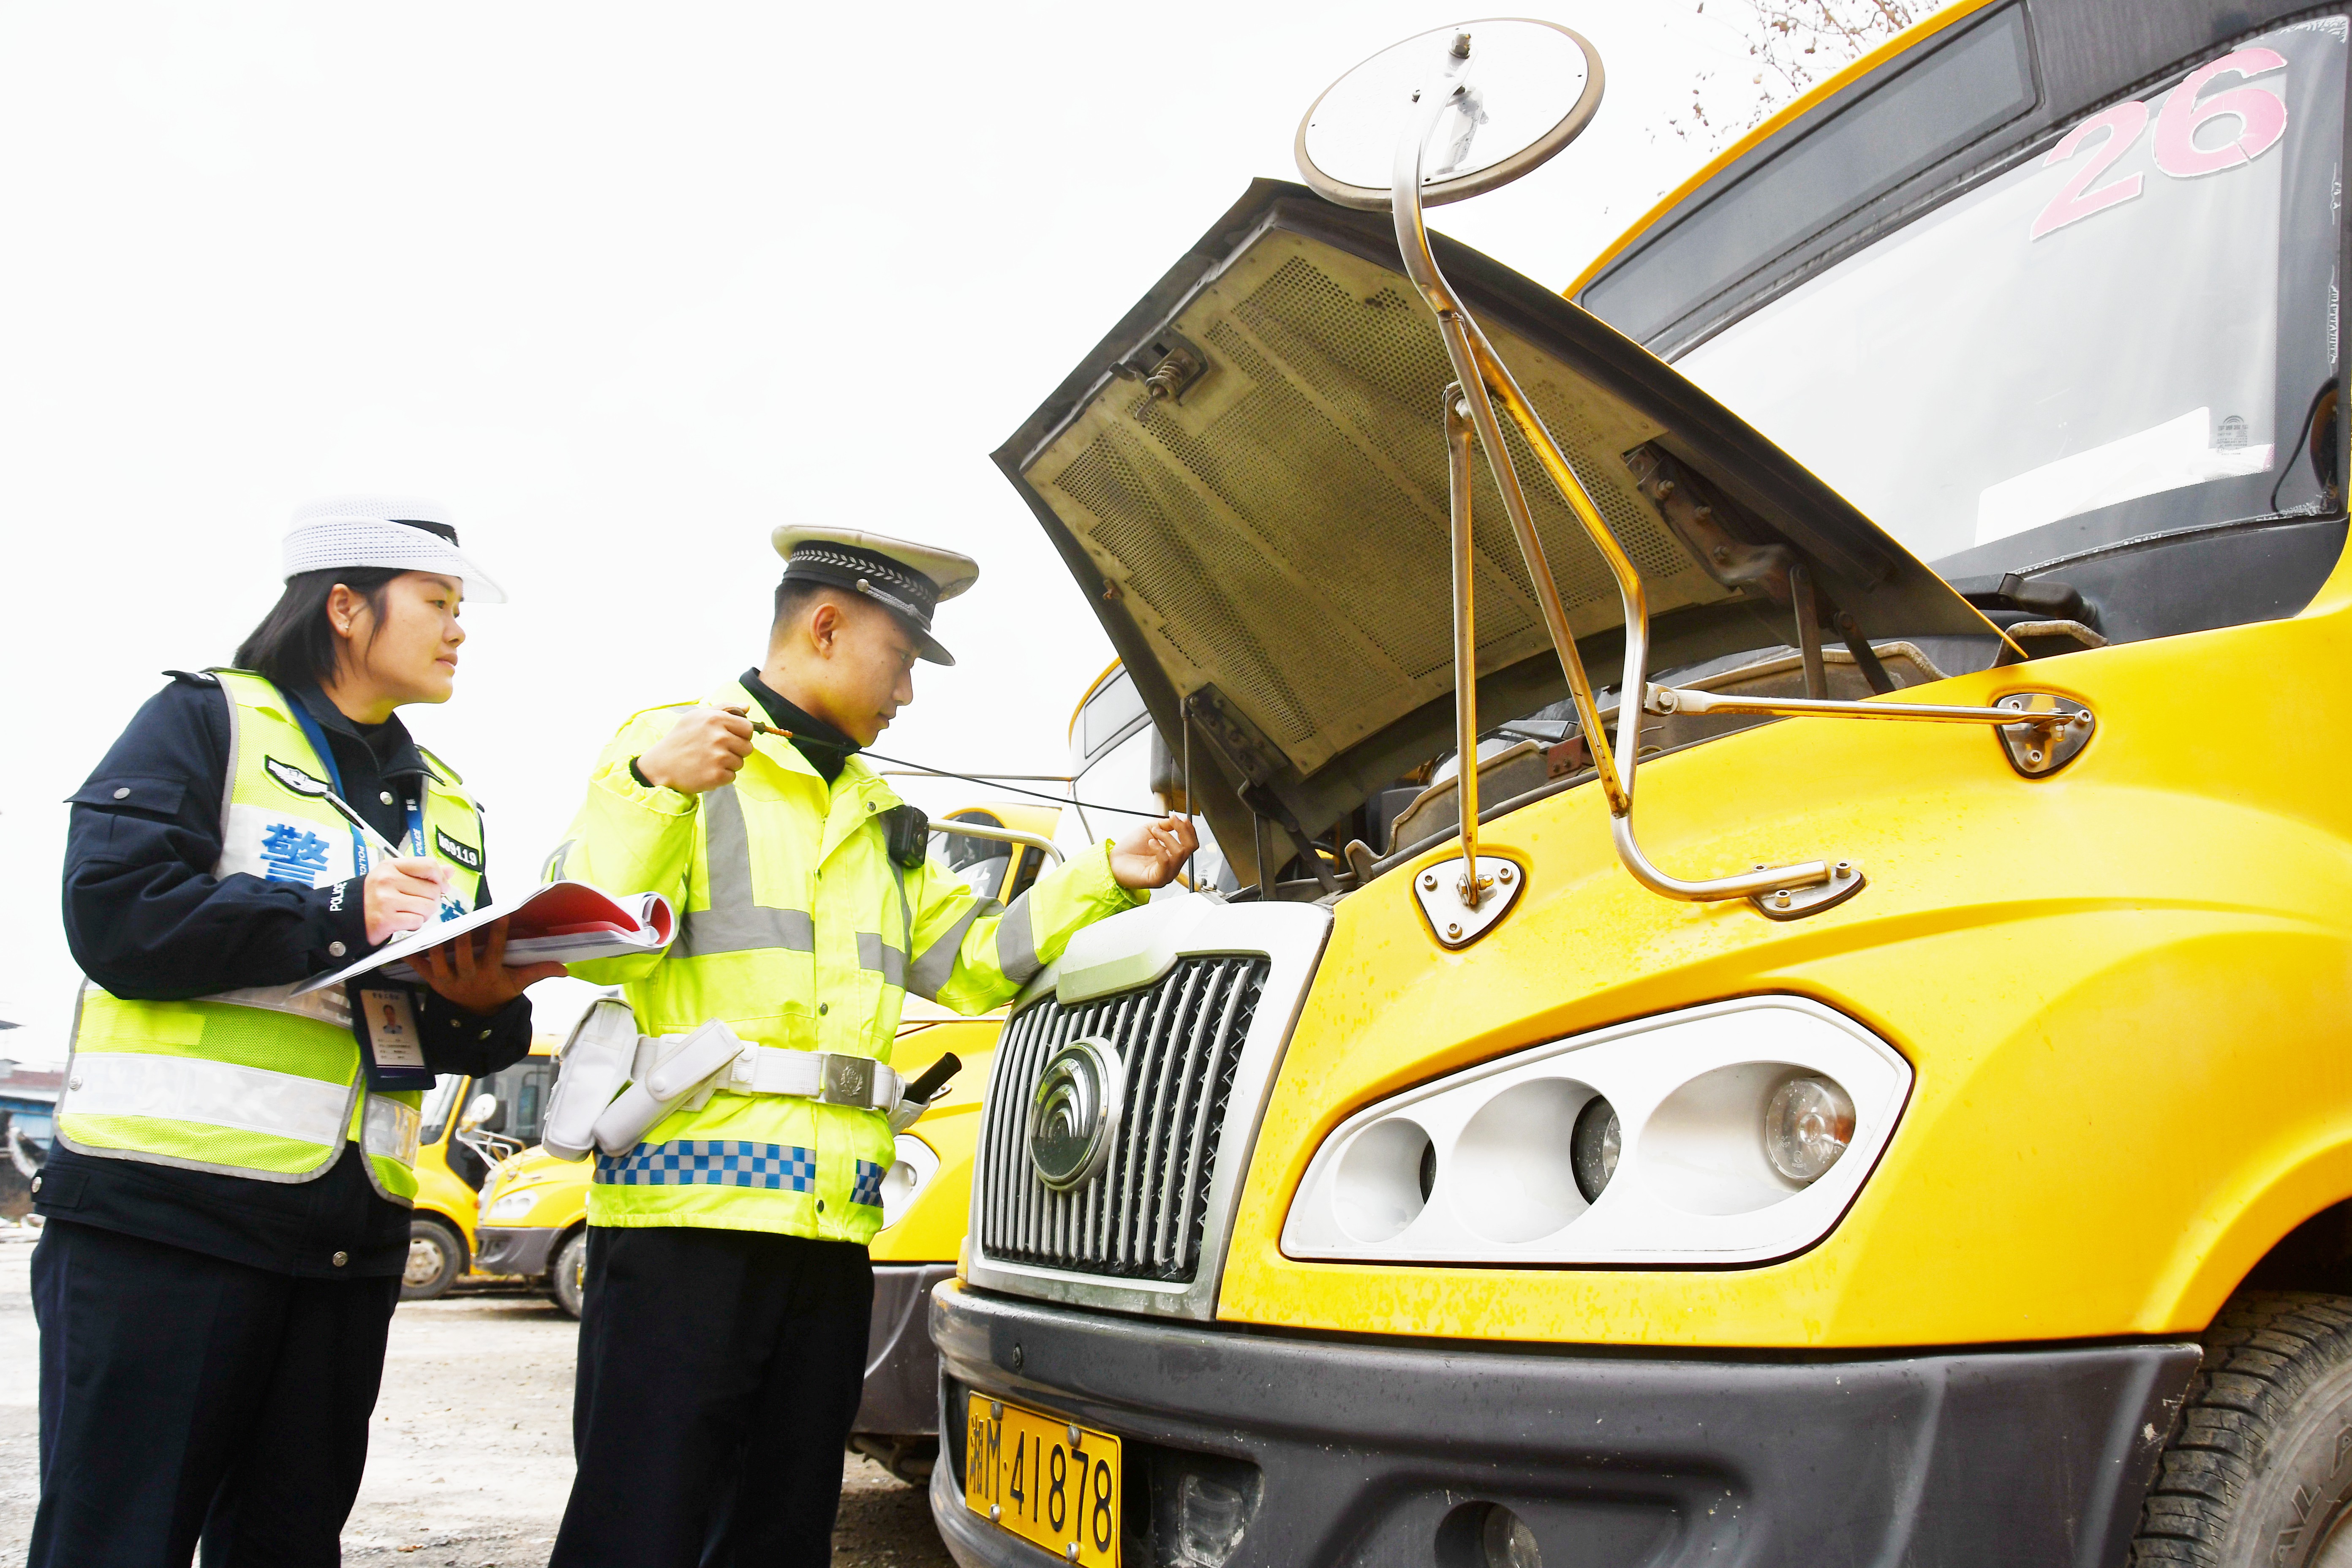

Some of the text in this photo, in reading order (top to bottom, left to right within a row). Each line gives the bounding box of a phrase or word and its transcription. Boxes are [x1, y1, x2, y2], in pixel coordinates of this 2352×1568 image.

[2029, 47, 2287, 242] 26
[259, 823, 329, 890] 警
[412, 827, 423, 856] POLICE
